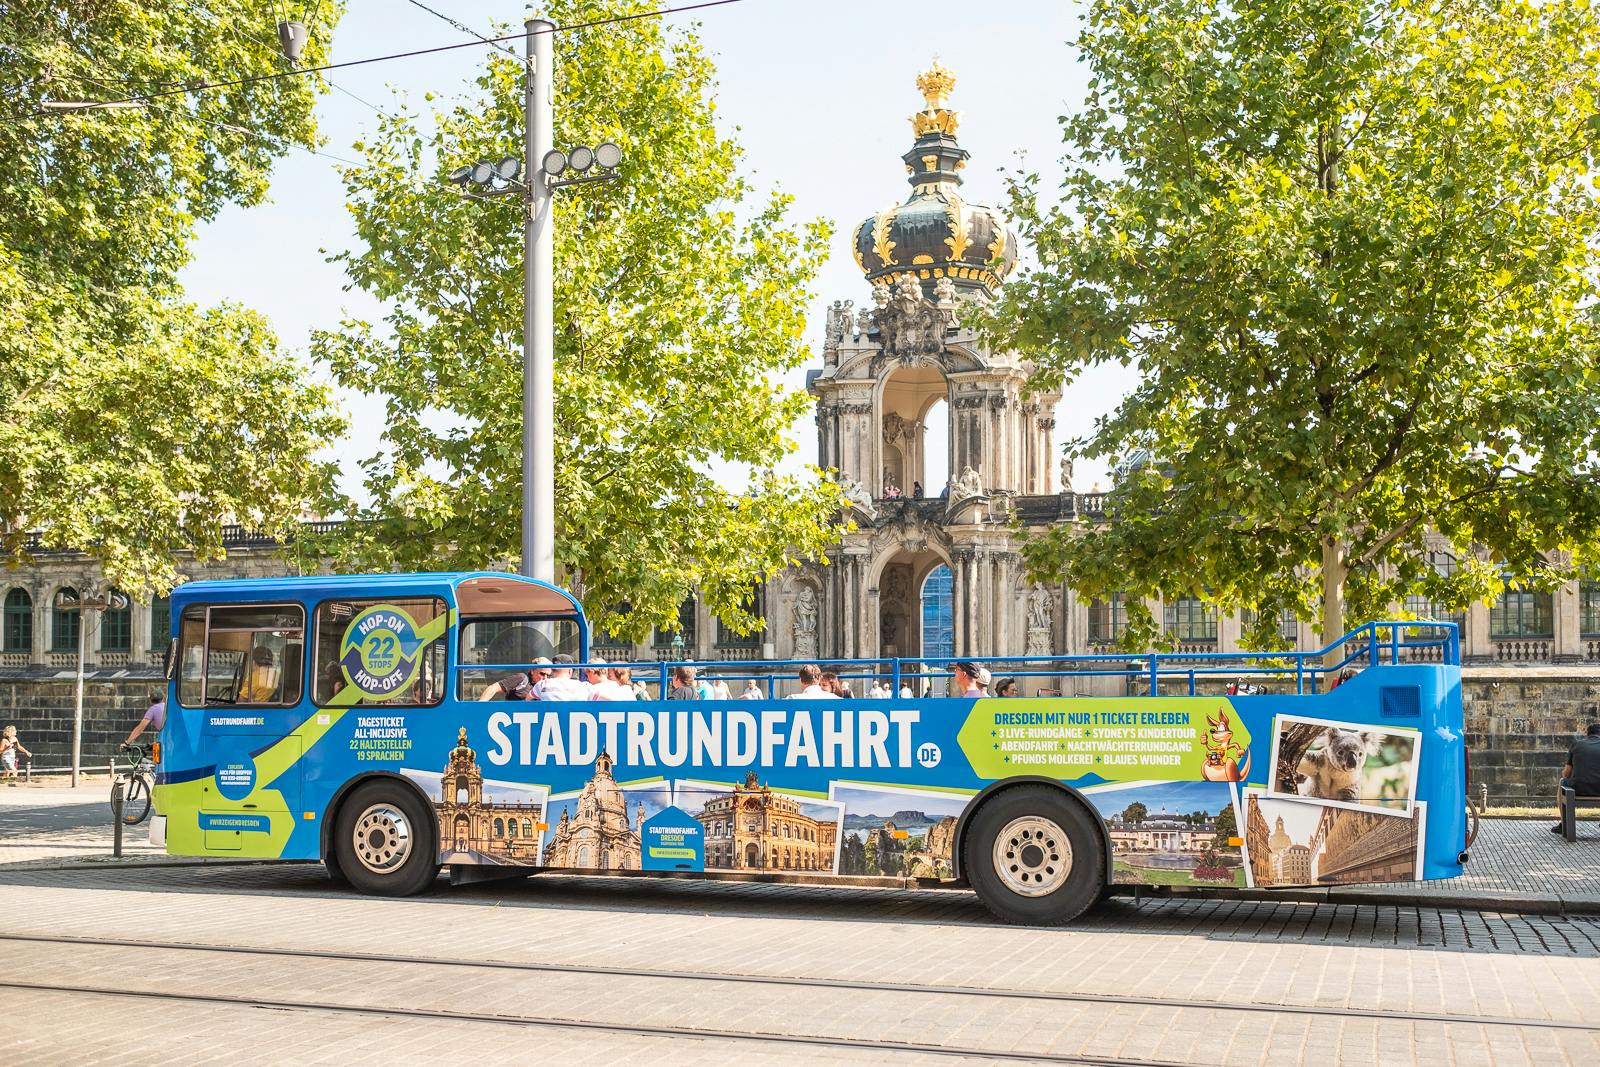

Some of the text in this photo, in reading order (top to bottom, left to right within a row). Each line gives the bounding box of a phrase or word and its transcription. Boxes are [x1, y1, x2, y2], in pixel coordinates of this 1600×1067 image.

[358, 614, 405, 635] HOP-ON
[368, 636, 395, 659] 22
[368, 660, 392, 669] STOPS
[354, 669, 403, 691] HOP-OFF
[357, 716, 405, 727] TAGESTICKET
[994, 712, 1190, 725] DRESDEN MIT NUR 1 TICKET ERLEBEN
[354, 728, 408, 739] ALL-INCLUSIVE
[998, 728, 1005, 739] 3
[1006, 727, 1083, 739] LIVE-RUNDGÄNGE
[1092, 728, 1136, 739] SYDNEY'S
[1137, 728, 1197, 739] KINDERTOUR
[349, 739, 412, 750] 22 HALTESTELLEN
[1001, 741, 1059, 752] ABENDFAHRT
[1067, 740, 1193, 753] NACHTWÄCHTERRUNDGANG
[357, 750, 405, 761] 19 SPRACHEN
[1011, 754, 1047, 765] PFUNDS
[1048, 754, 1094, 765] MOLKEREI
[1103, 754, 1138, 765] BLAUES
[1139, 754, 1182, 766] WUNDER
